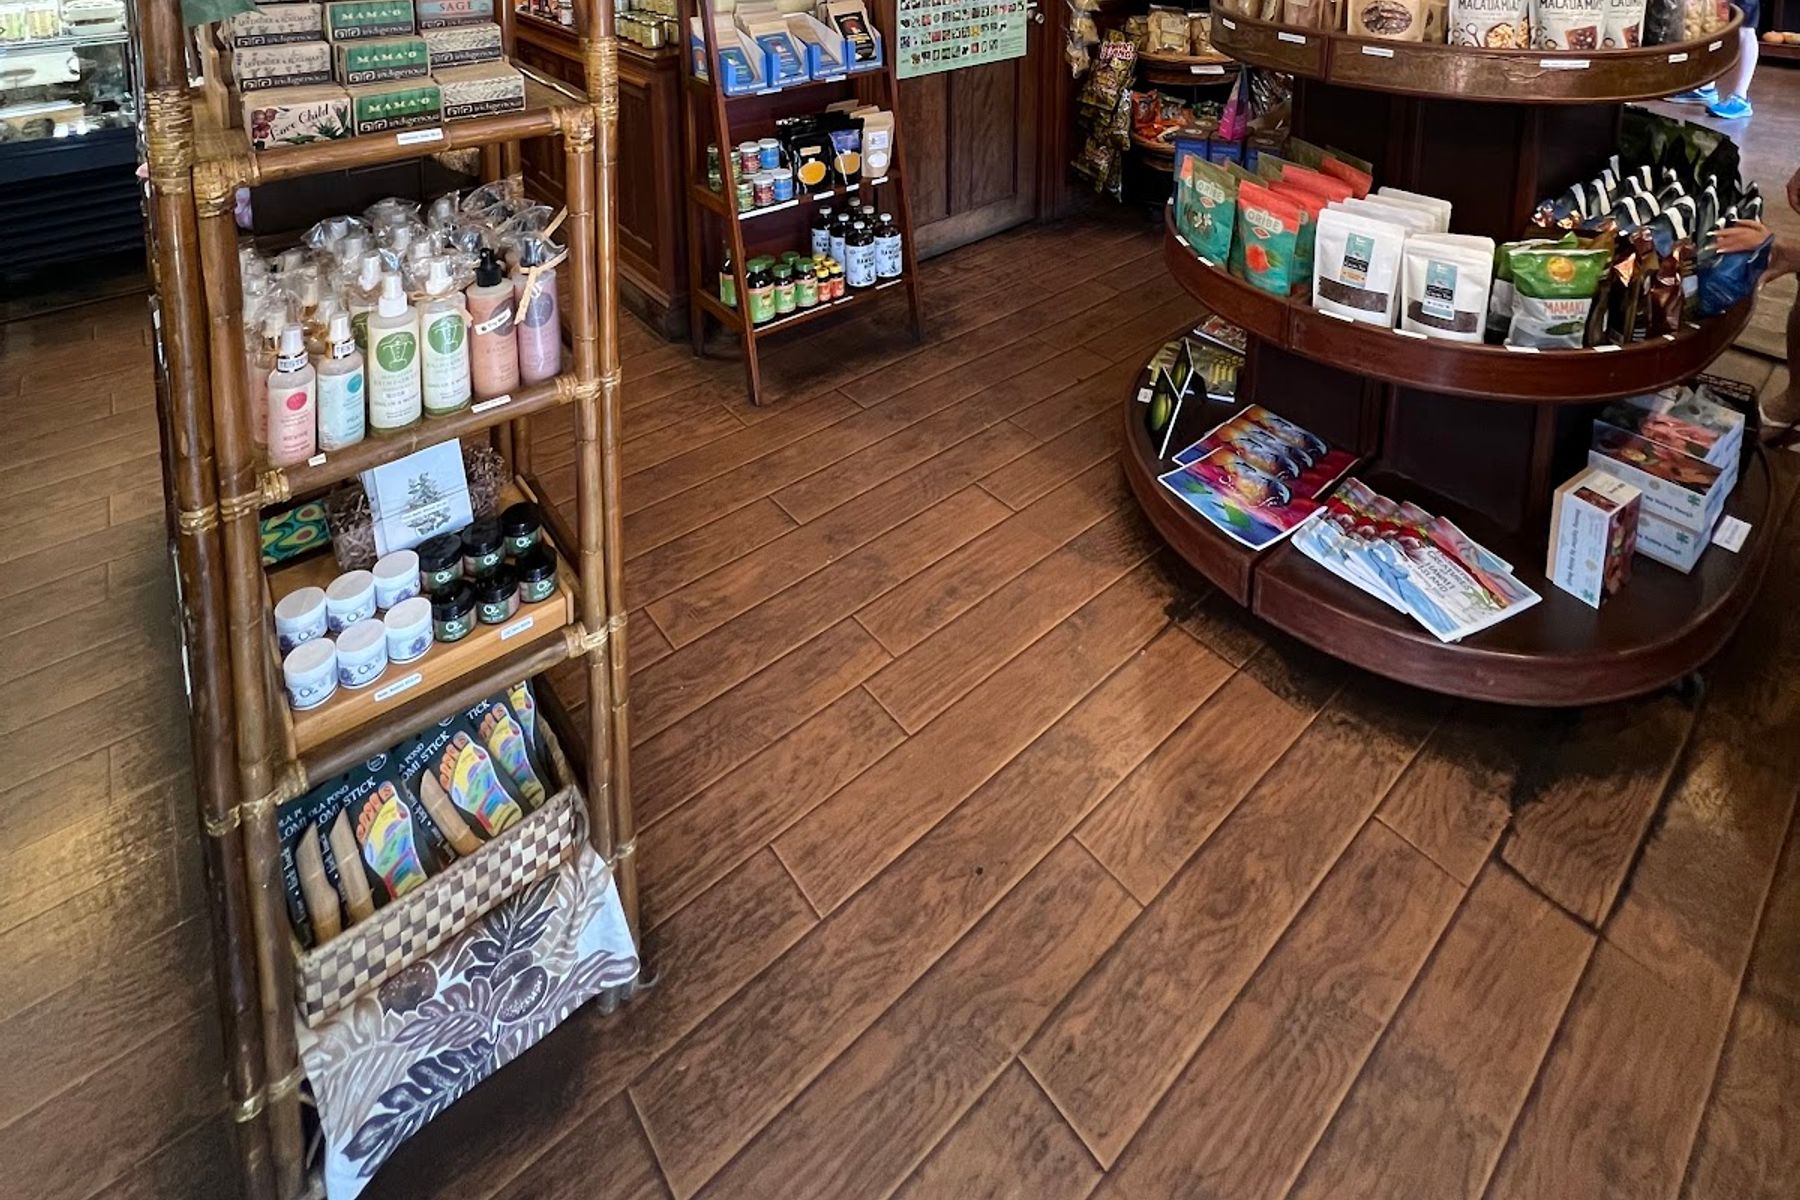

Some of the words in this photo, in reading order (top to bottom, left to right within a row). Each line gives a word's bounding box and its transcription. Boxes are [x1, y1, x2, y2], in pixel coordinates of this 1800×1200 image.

[439, 1, 472, 11] SAGE
[299, 103, 329, 124] Child
[336, 343, 354, 354] TEST
[280, 359, 304, 368] TESTE
[466, 699, 491, 720] TICK
[401, 760, 421, 782] OMI
[422, 730, 451, 763] STICK
[343, 775, 378, 808] STICK
